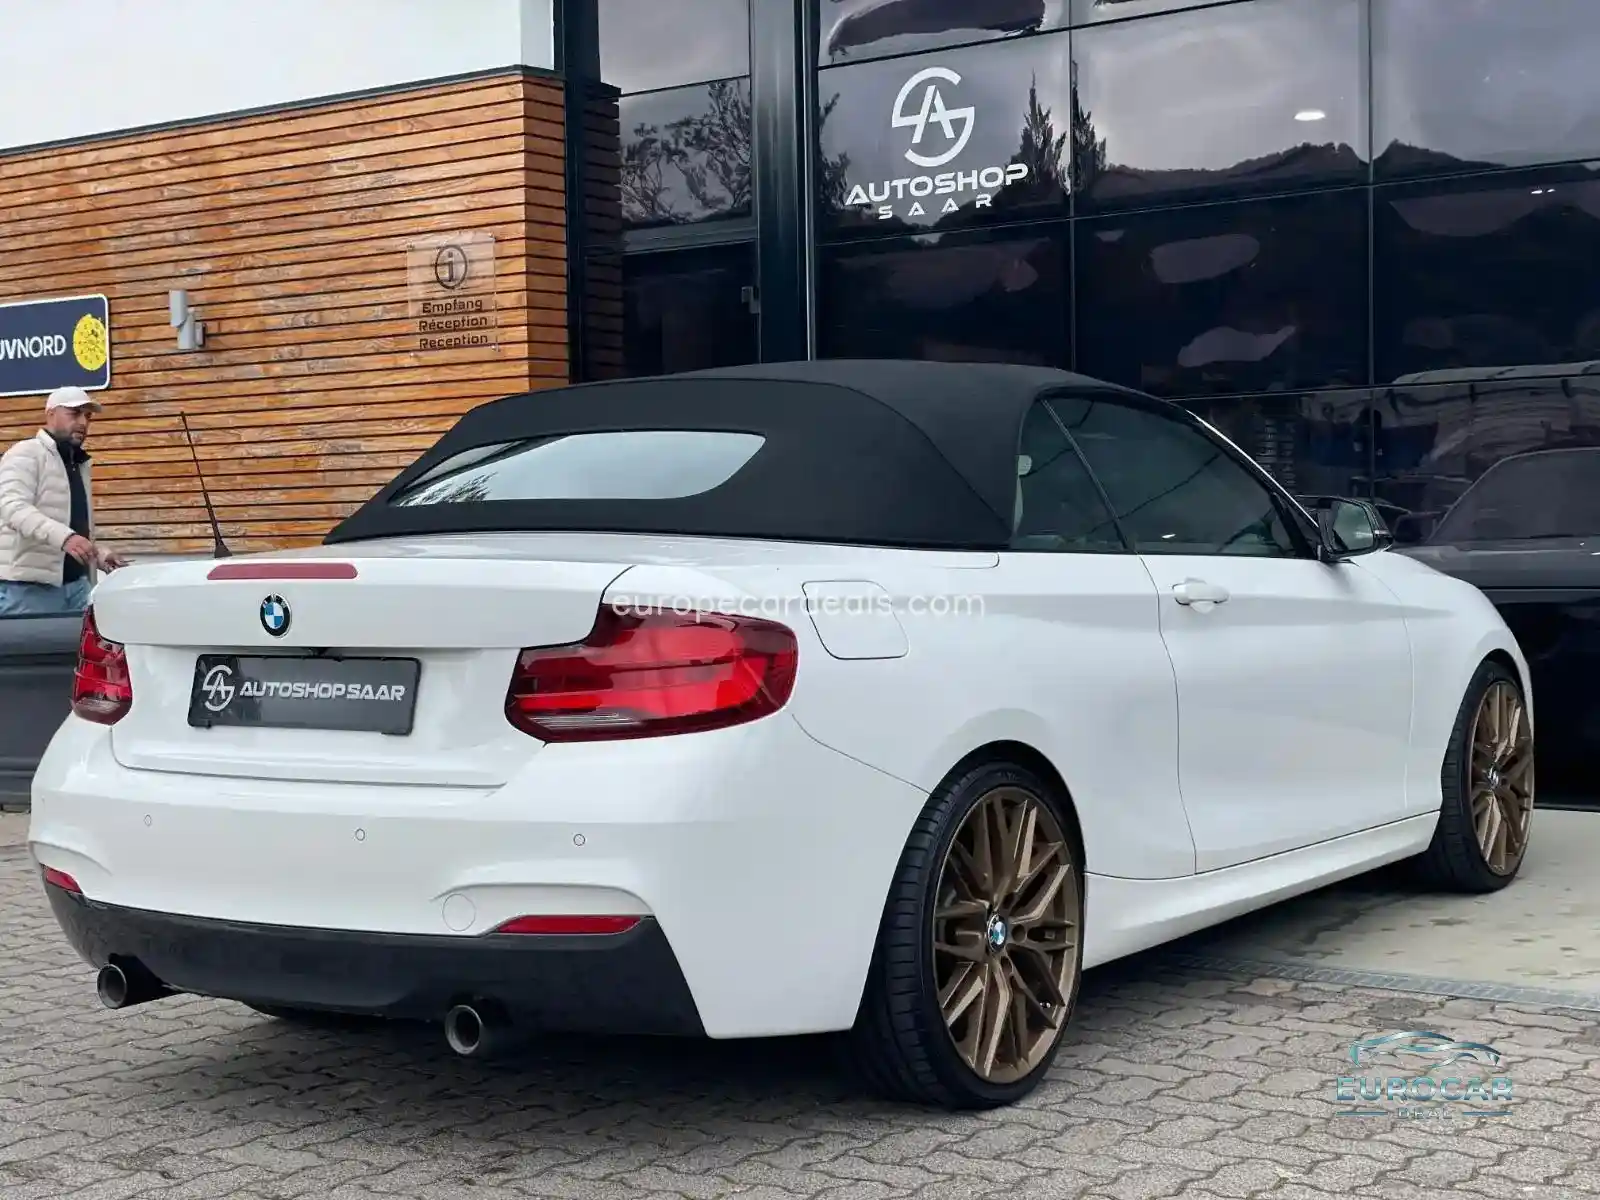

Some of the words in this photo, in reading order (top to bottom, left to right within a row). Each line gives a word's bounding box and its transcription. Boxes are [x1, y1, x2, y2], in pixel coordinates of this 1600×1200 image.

[844, 162, 1029, 206] AUTOSHOP
[877, 192, 992, 220] SAAR
[422, 299, 483, 315] Empfang
[418, 315, 488, 333] Réception
[419, 333, 488, 350] Reception
